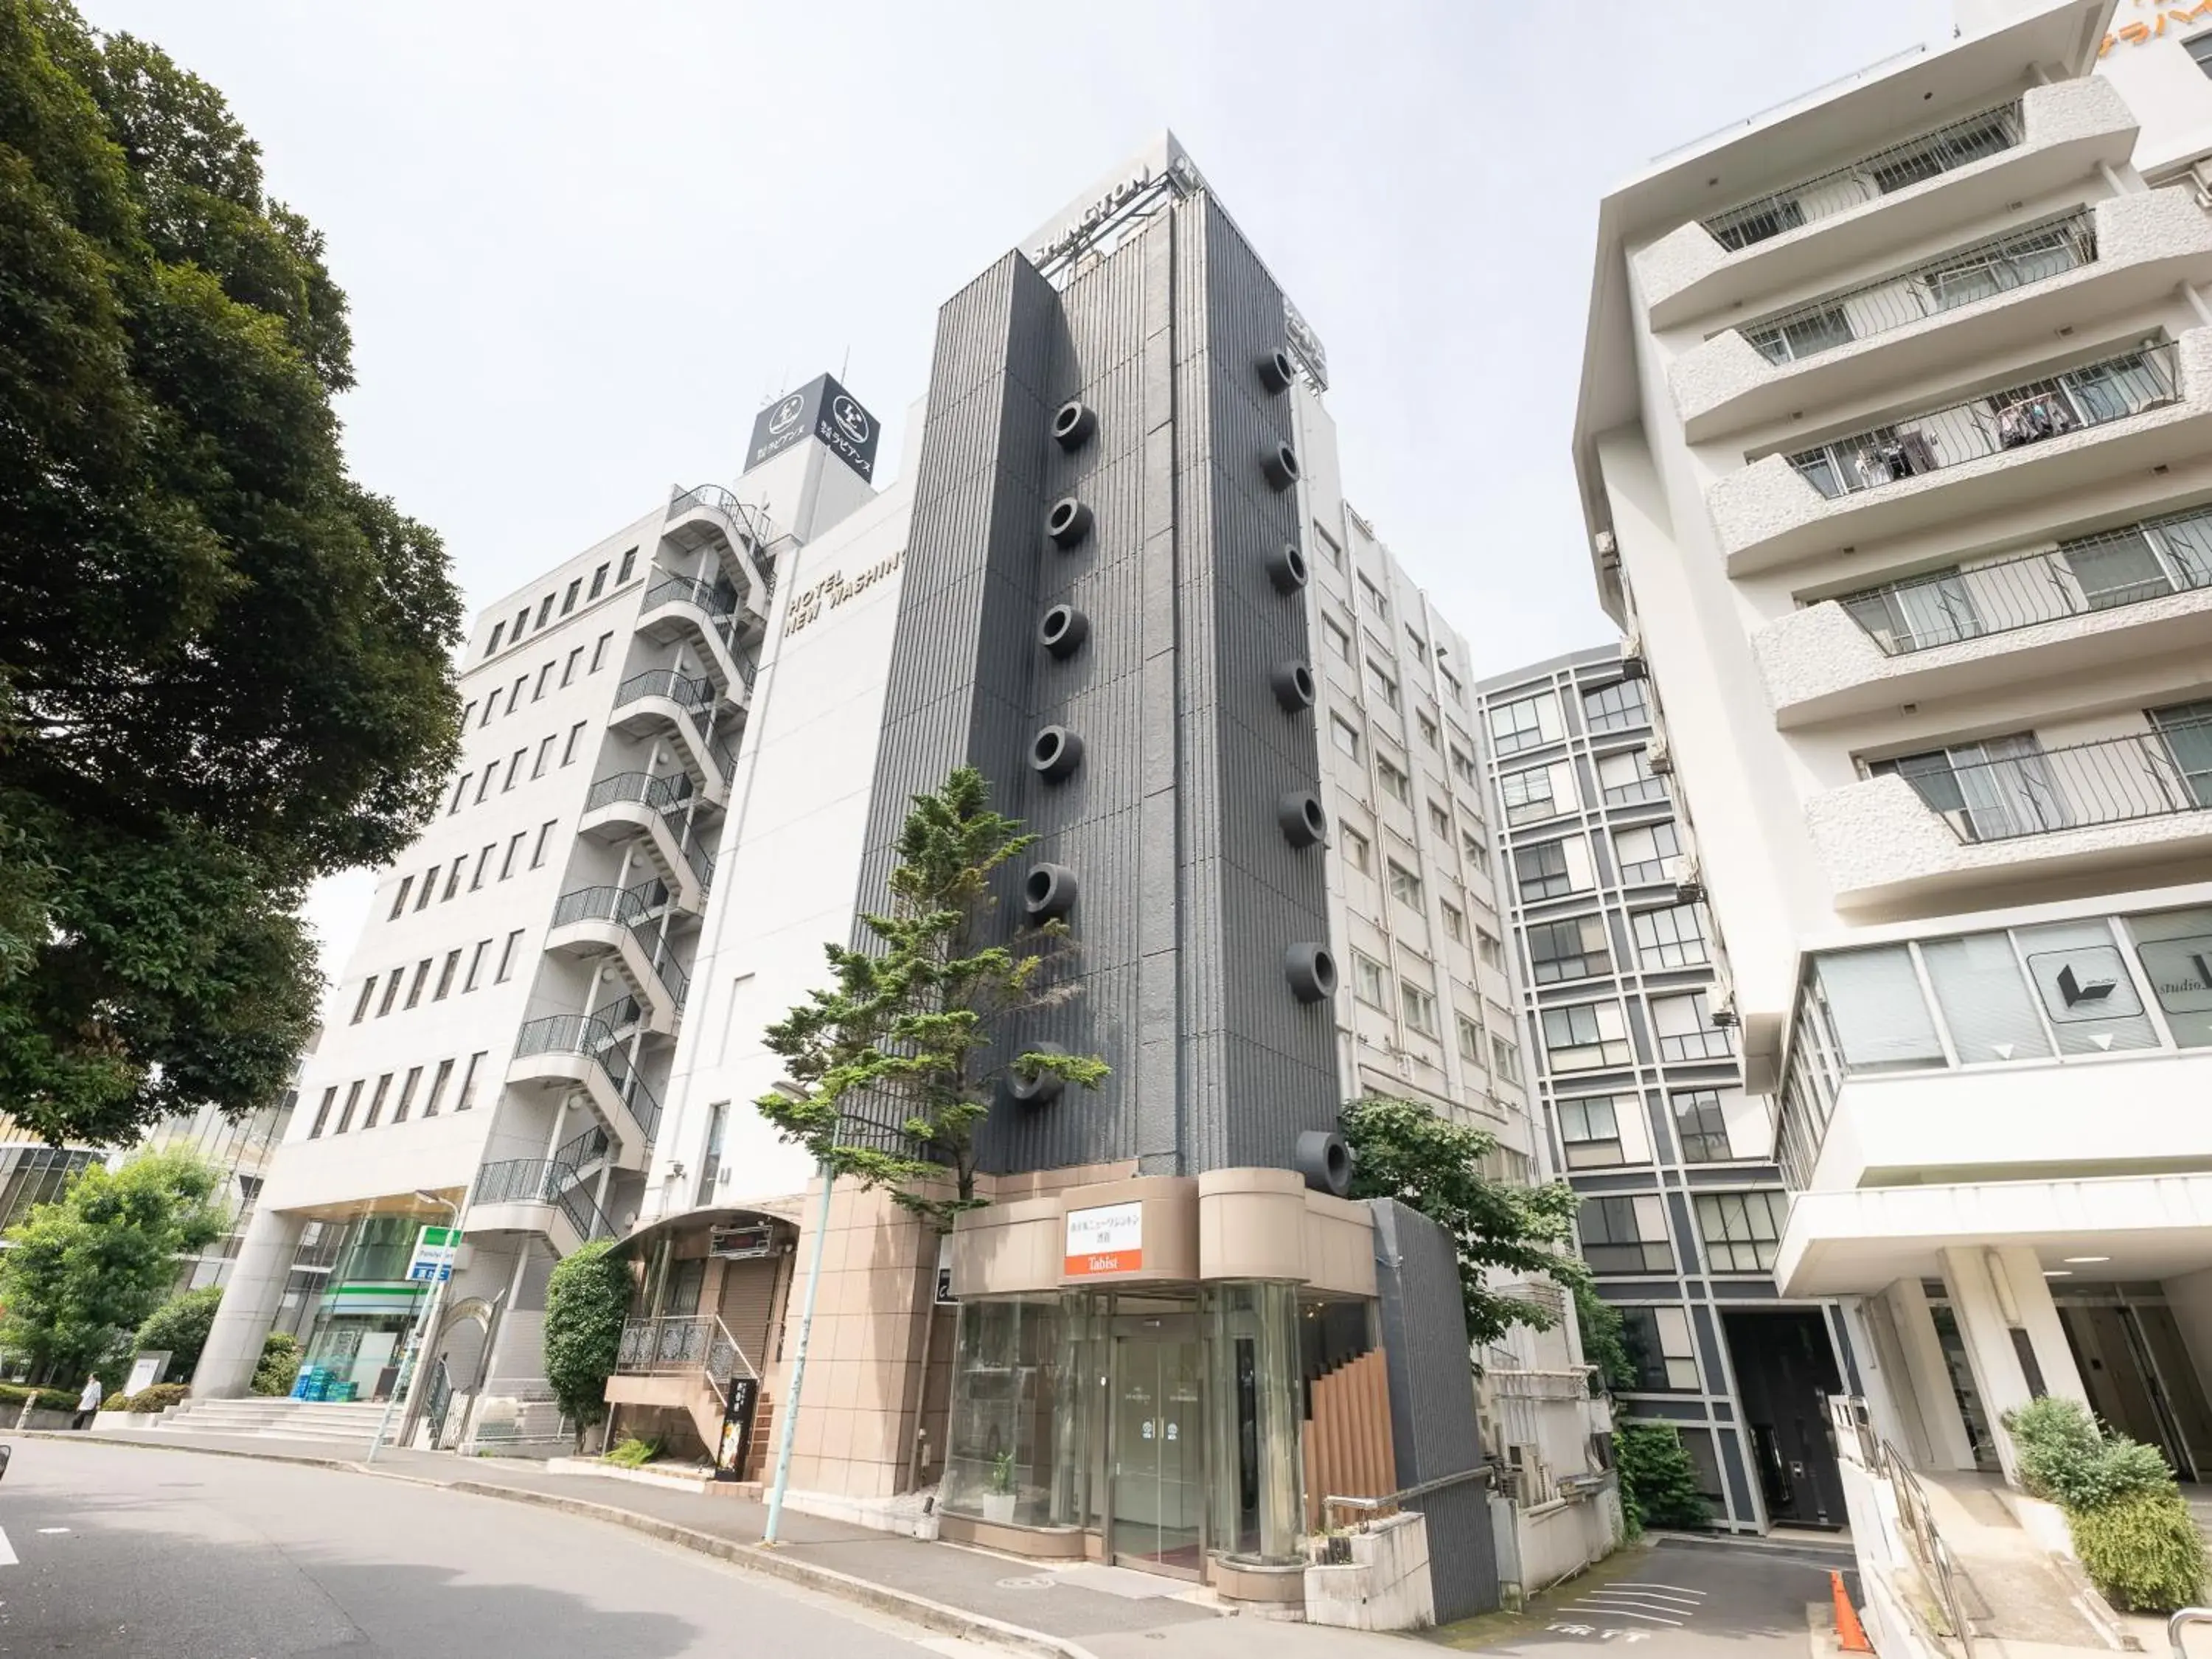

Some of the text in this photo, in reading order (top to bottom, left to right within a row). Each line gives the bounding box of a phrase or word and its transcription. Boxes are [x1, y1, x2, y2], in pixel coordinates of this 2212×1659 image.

[789, 569, 844, 616] HOTEL
[785, 601, 822, 638] NEW
[1088, 1256, 1119, 1270] Tabist
